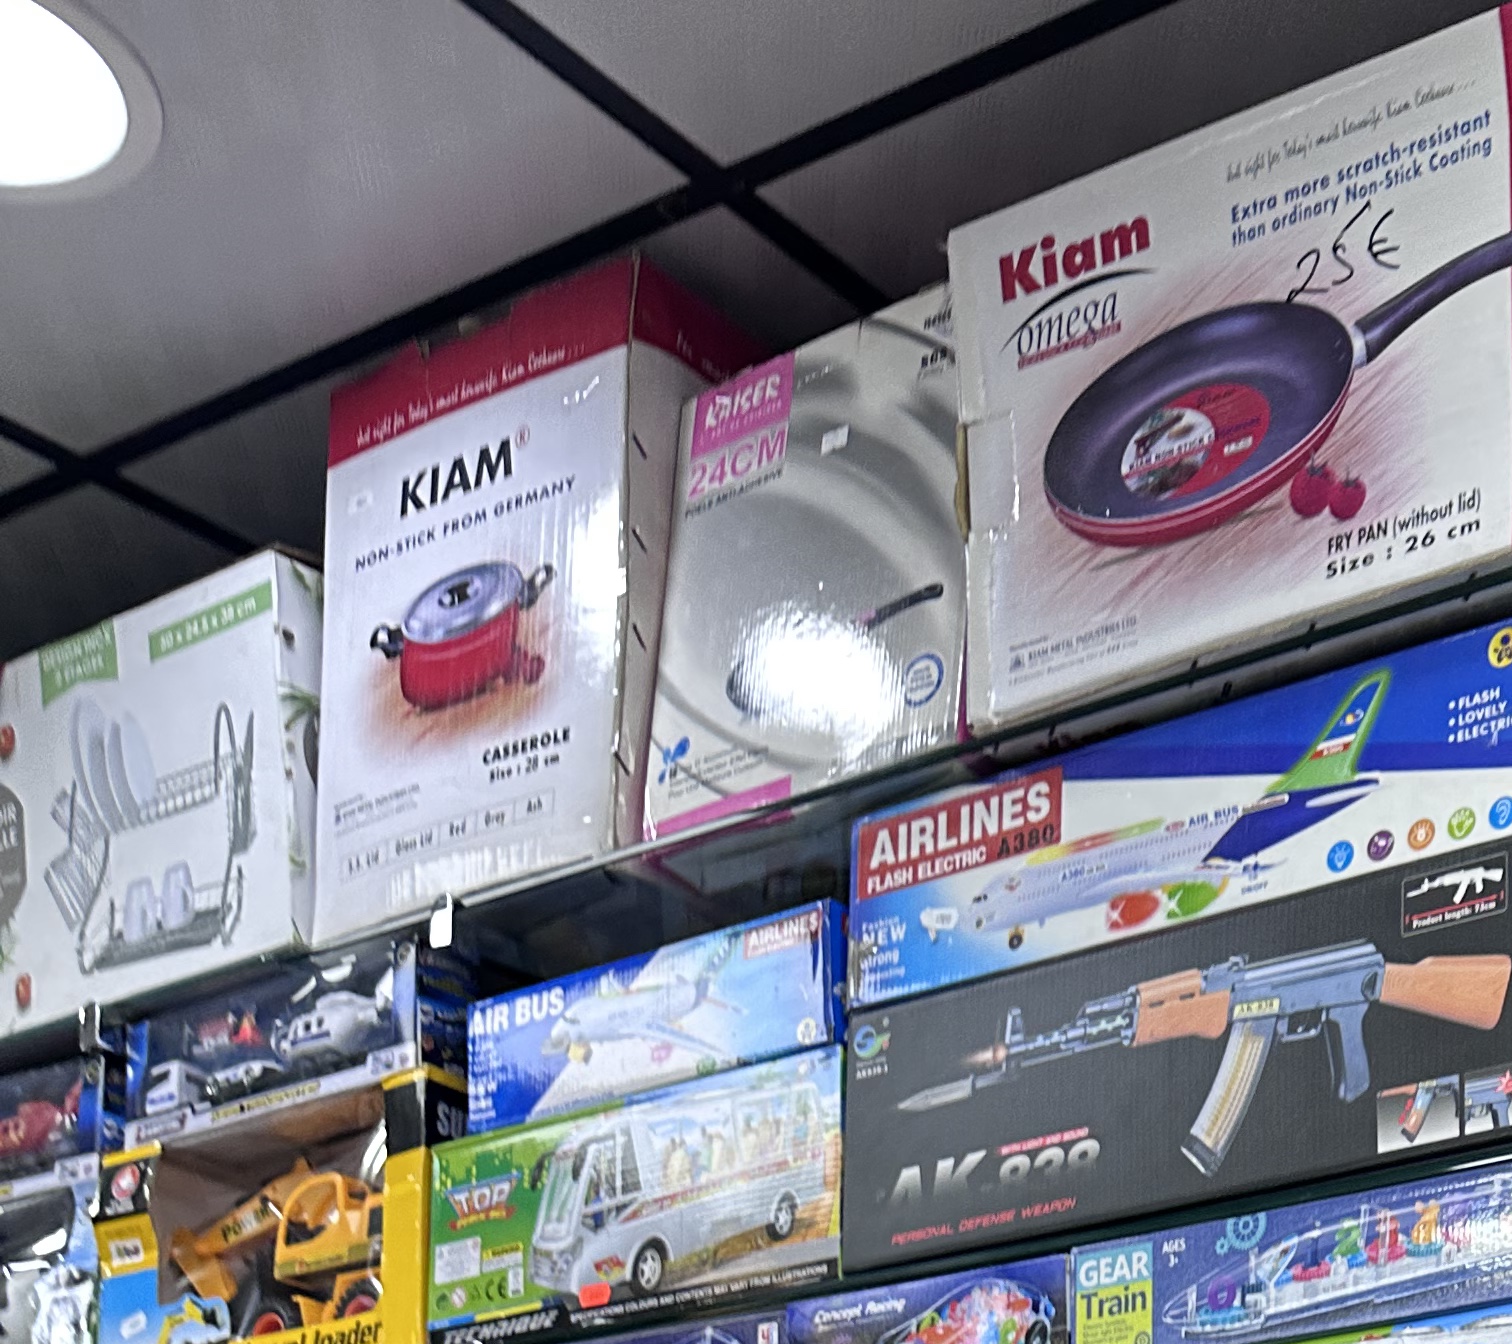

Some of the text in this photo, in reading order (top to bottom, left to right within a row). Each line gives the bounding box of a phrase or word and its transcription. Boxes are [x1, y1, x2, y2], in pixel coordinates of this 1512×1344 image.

[1231, 109, 1492, 224] Extra more scratch-resistant
[1232, 136, 1493, 247] than ordinary Non-Stick Coating
[999, 214, 1151, 305] Kiam
[1017, 290, 1119, 356] omega
[400, 435, 514, 521] KIAM
[688, 428, 788, 500] 24CM
[355, 473, 577, 573] NON-STICK FROM GERMANY
[1328, 486, 1483, 557] FRY PAN (without lid)
[1326, 517, 1481, 580] Size 26 cm
[1458, 686, 1501, 709] FLASH
[1458, 699, 1507, 727] LOVELY
[483, 725, 572, 766] CASSEROLE
[869, 780, 1051, 871] AIRLINES
[1188, 804, 1240, 829] AIR BUS
[866, 823, 1056, 896] FLASH ELECTRIC A380
[748, 908, 820, 945] AIRLINES
[862, 923, 906, 948] NEW
[1412, 905, 1473, 930] Product length:
[470, 985, 566, 1036] AIR BUS
[453, 1178, 512, 1215] TOP
[891, 1150, 988, 1204] AK
[891, 1196, 1077, 1247] PERSONAL DEFENSE WEAPON
[1078, 1250, 1149, 1289] GEAR
[1162, 1240, 1187, 1256] AGES
[813, 1298, 906, 1326] Concept Racing
[1080, 1284, 1148, 1320] Train
